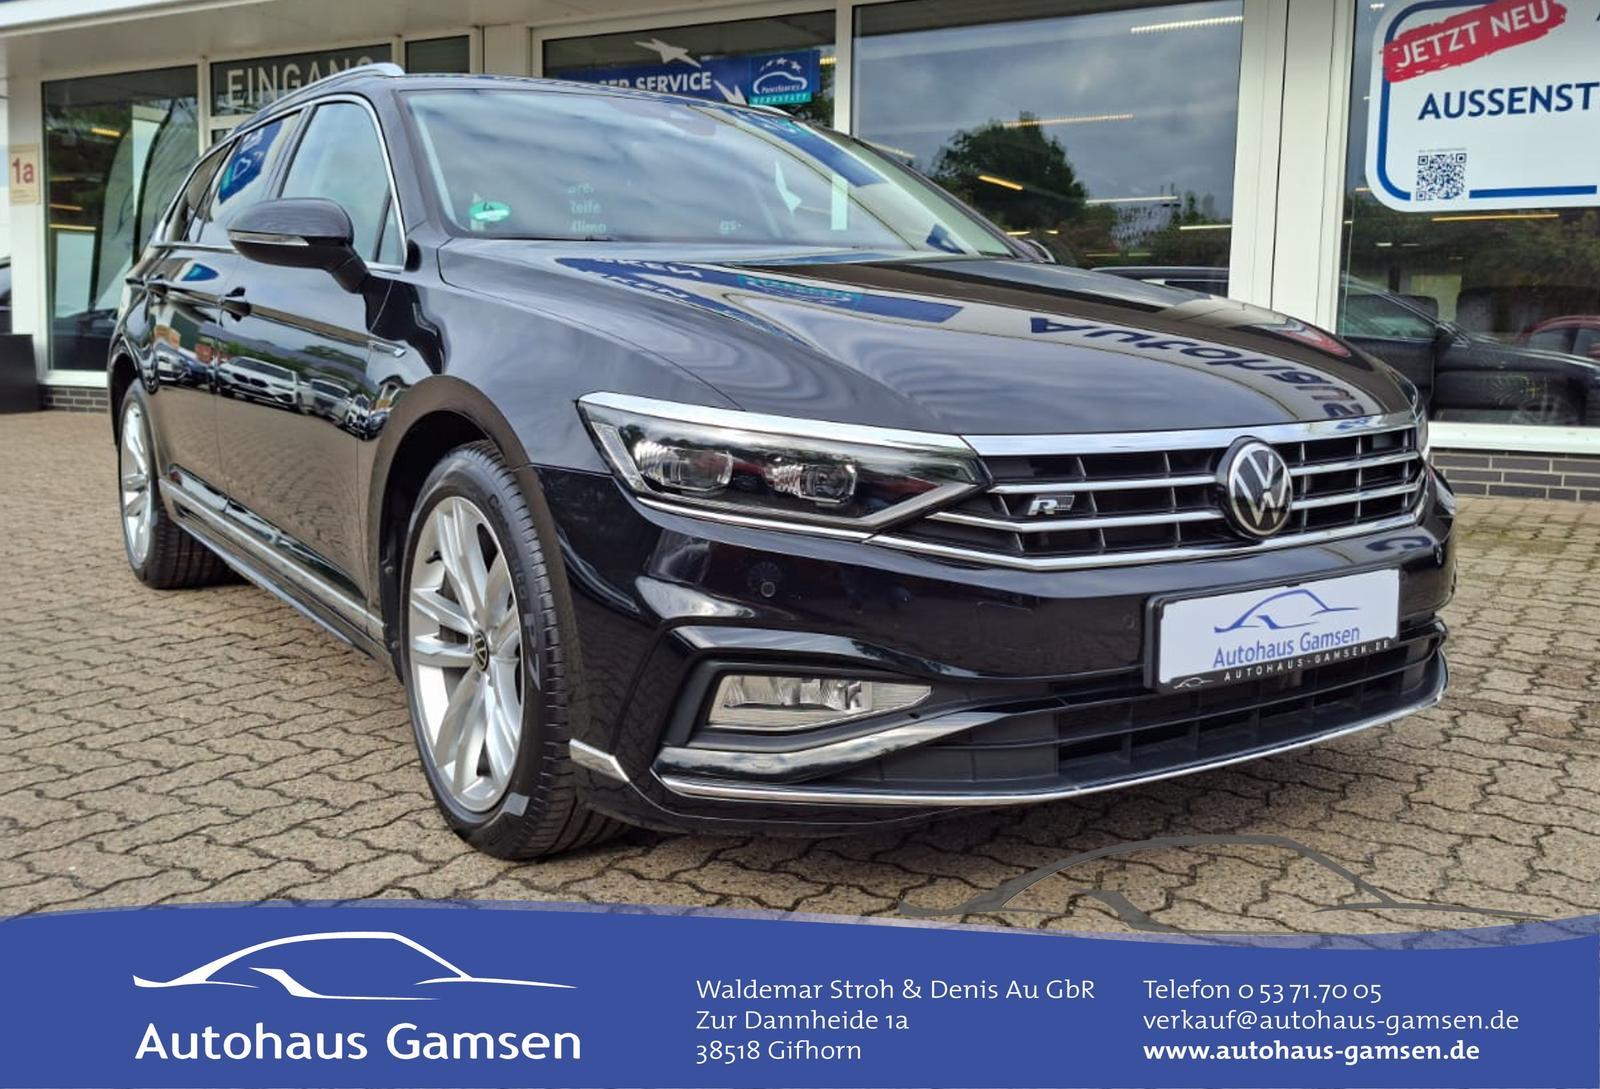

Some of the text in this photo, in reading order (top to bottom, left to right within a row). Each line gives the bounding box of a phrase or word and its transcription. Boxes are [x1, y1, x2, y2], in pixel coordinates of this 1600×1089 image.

[1396, 0, 1550, 68] JETZT NEU
[227, 56, 374, 106] EINGA
[635, 71, 712, 93] SERVICE
[12, 157, 34, 184] 1a
[1213, 626, 1360, 669] Autohaus Gamsen
[1224, 639, 1390, 681] AUTOHAUS-GAMSEN.DE
